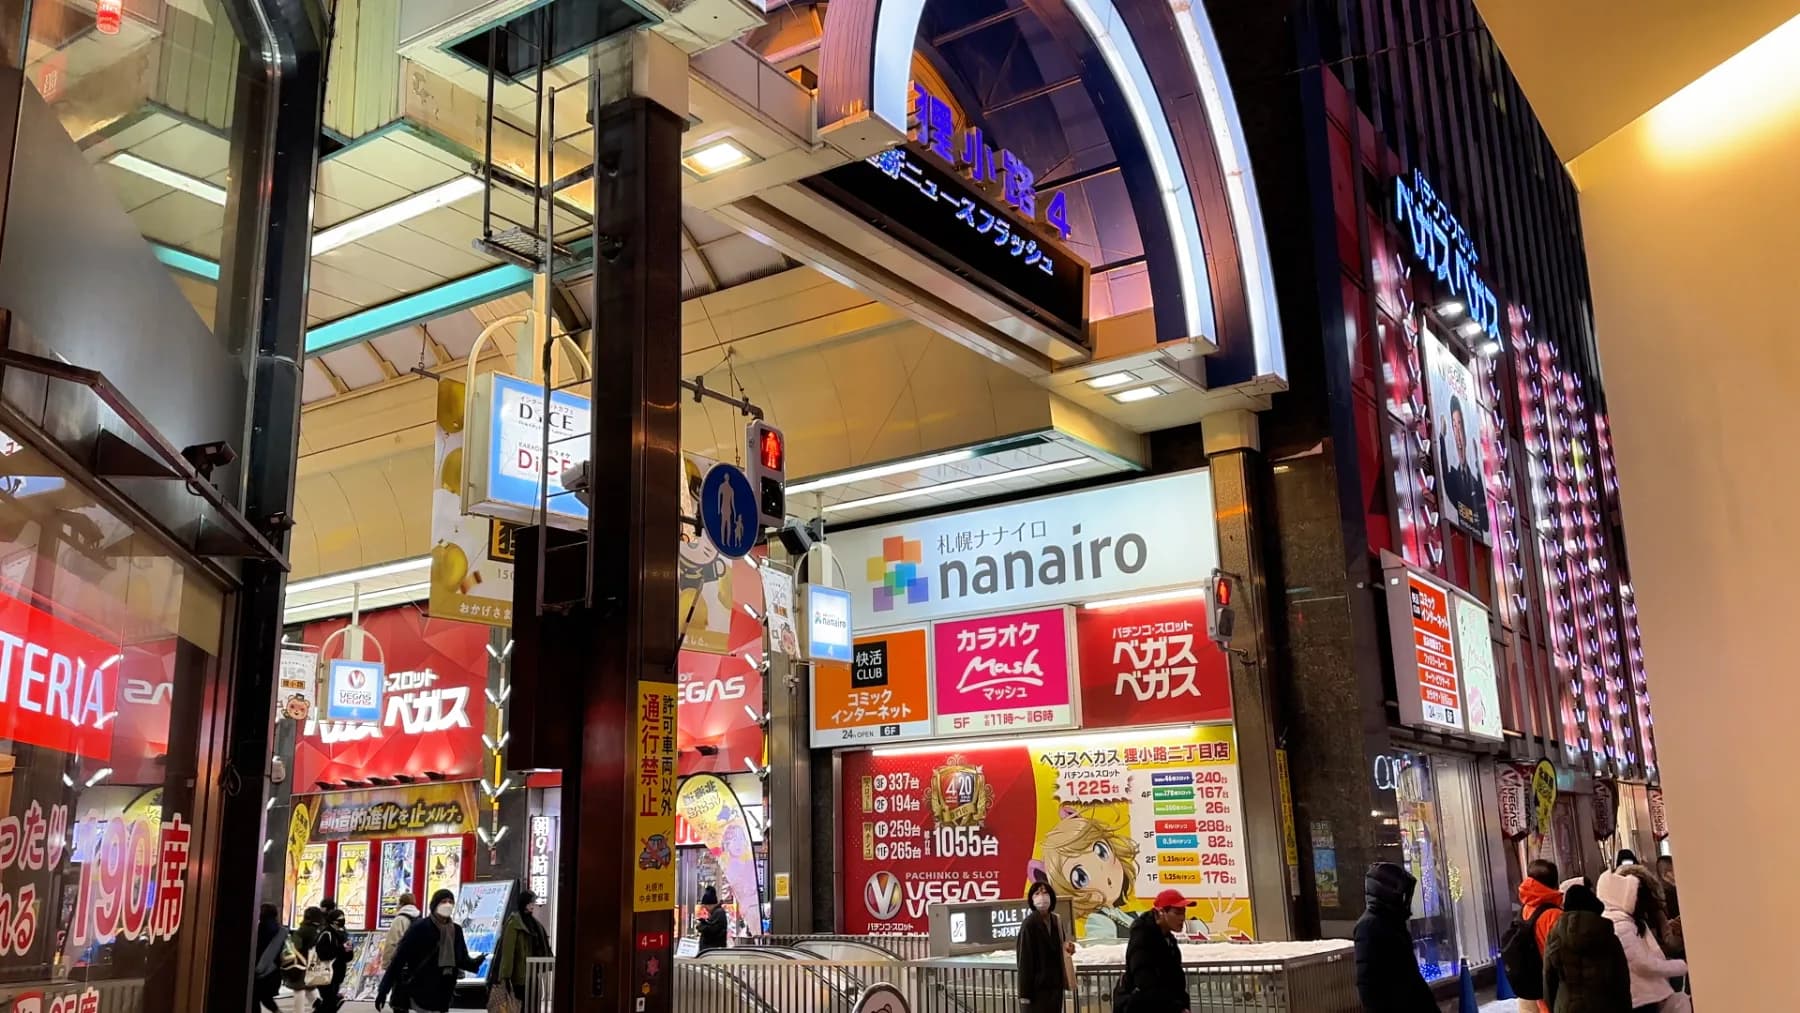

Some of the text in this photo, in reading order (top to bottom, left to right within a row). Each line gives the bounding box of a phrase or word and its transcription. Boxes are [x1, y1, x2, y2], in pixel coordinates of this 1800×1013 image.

[936, 519, 1047, 555] 札幌ナナイロ
[939, 524, 1148, 600] nanairo
[822, 617, 847, 629] nanairo
[956, 621, 1040, 653] カラオケ
[855, 649, 882, 667] 快活
[1113, 634, 1198, 669] ベガス
[856, 667, 883, 680] CLUB
[956, 648, 1044, 690] Mash
[982, 685, 1028, 701] マッシュ
[1115, 666, 1201, 701] ベガス
[848, 689, 892, 707] コミック
[831, 702, 912, 724] インターネット
[884, 726, 897, 735] 6F
[953, 717, 970, 729] 5F
[640, 693, 660, 817] 通行禁止
[661, 694, 674, 817] 許可車両以外
[1123, 742, 1230, 764] 狸小路二丁目店
[876, 772, 920, 791] 3F 337台
[1066, 780, 1120, 797] 1225台
[876, 794, 920, 812] 2F 194台
[878, 819, 921, 838] 1F 259台
[890, 842, 922, 860] 265台
[932, 825, 999, 858] 1055台
[1145, 856, 1157, 864] 2F
[73, 809, 192, 946] 190席
[905, 870, 1000, 880] PACHINKO & SLOT
[905, 880, 1001, 900] VEGAS
[991, 909, 1017, 923] POLE
